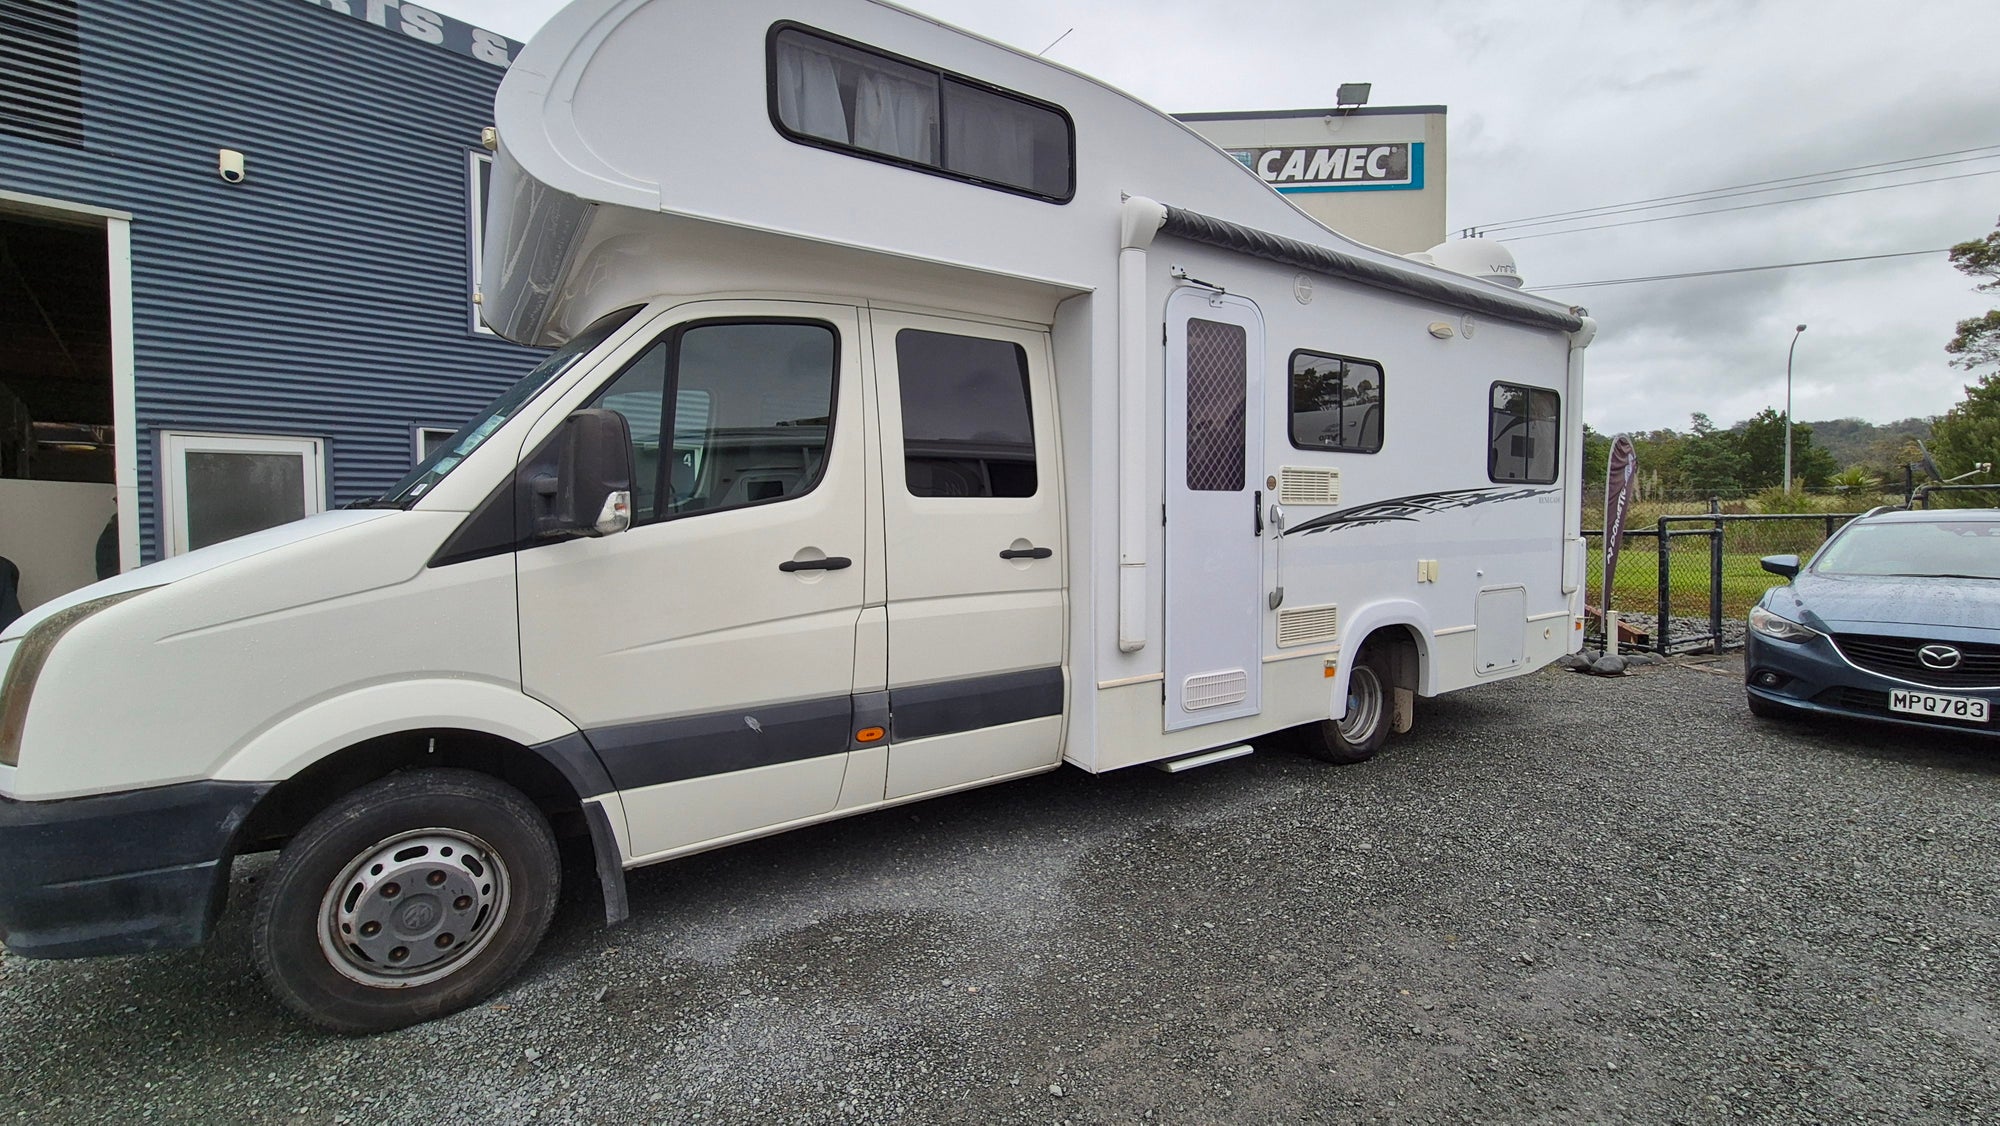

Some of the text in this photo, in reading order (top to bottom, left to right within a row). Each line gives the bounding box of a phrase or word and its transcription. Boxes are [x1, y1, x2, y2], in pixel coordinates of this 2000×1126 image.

[472, 28, 511, 69] &
[1257, 146, 1391, 181] CAMEC
[1894, 693, 1984, 718] MPQ703
